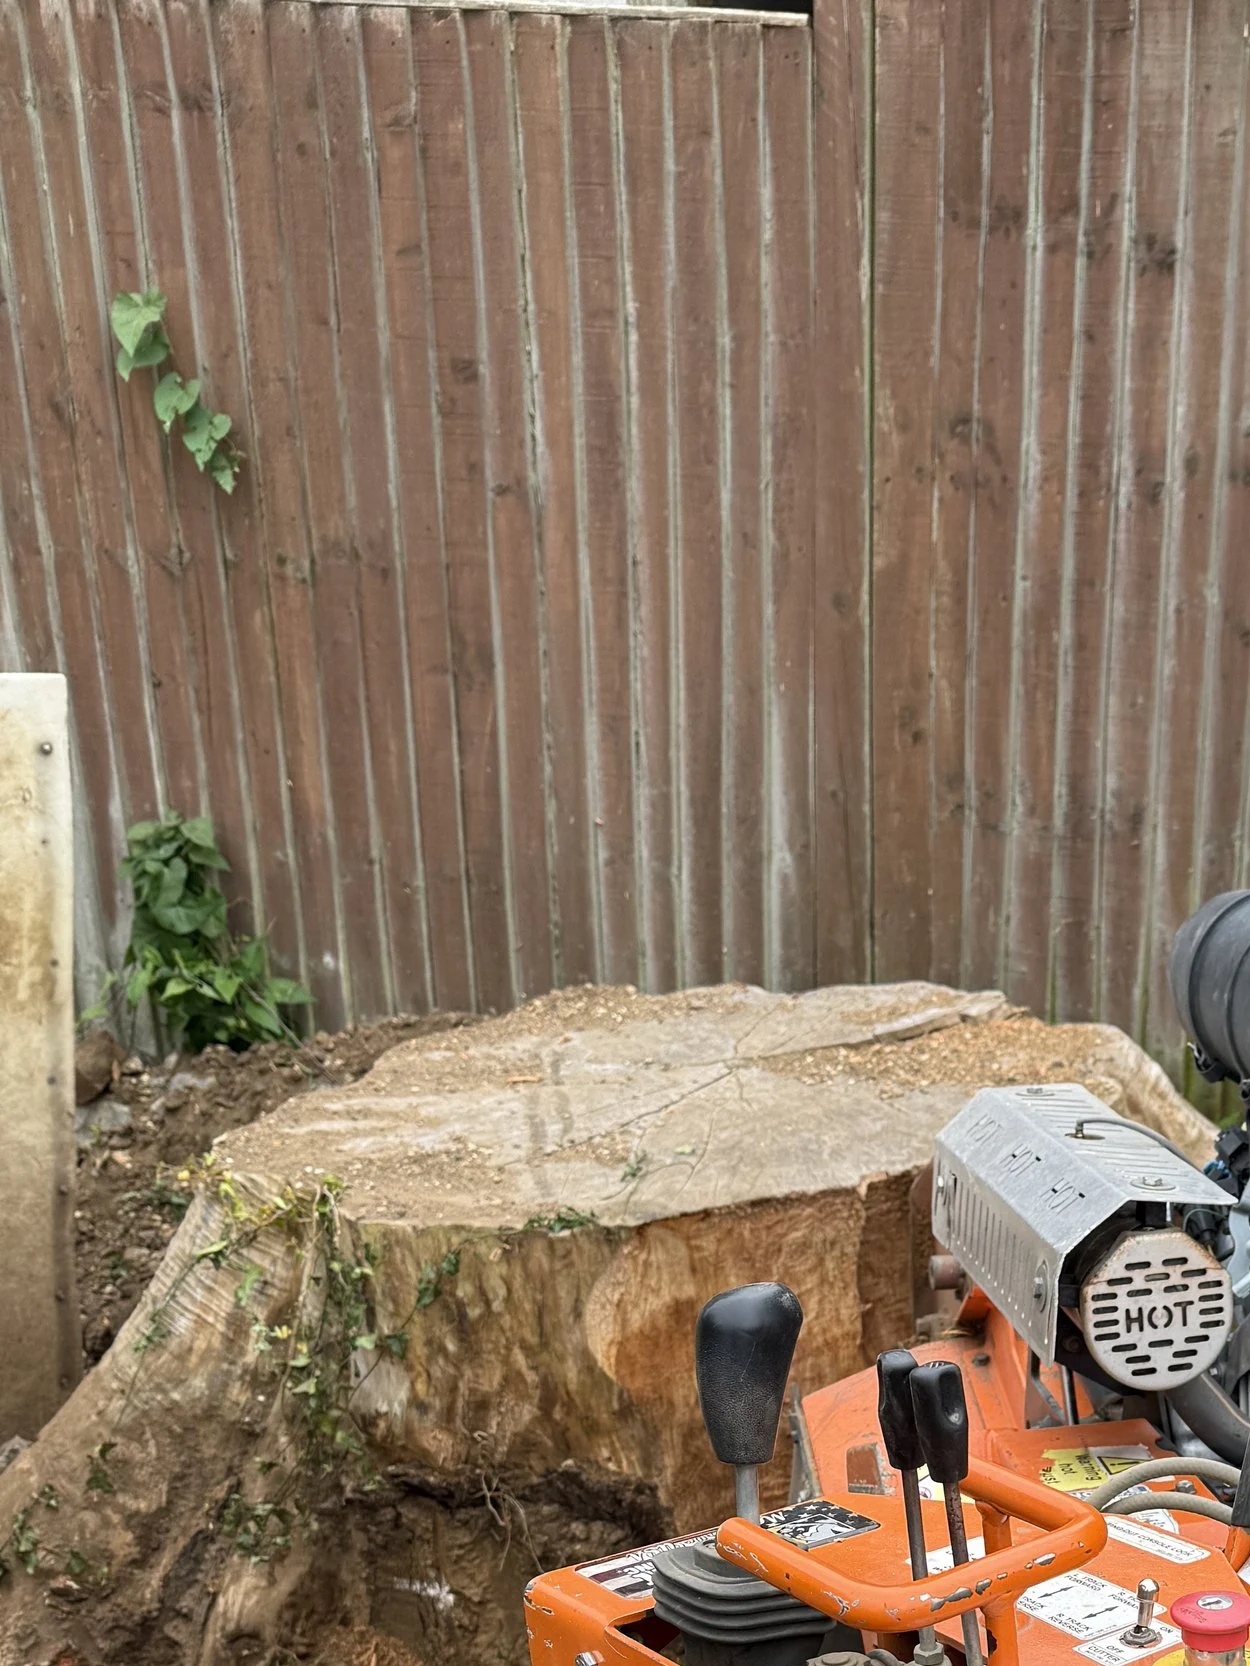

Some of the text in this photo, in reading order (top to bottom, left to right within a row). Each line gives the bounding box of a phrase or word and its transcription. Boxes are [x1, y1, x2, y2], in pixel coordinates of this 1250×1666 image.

[1000, 1142, 1042, 1177] HOT
[1040, 1177, 1086, 1214] HOT
[1125, 1300, 1195, 1334] HOT
[1063, 1575, 1103, 1592] FORWARD
[1081, 1576, 1107, 1589] TRACK
[1048, 1615, 1085, 1635] REVERSE
[1064, 1617, 1091, 1632] TRACK
[1159, 1626, 1174, 1634] ON
[1087, 1645, 1122, 1663] CUTTER
[1106, 1645, 1125, 1655] OFF
